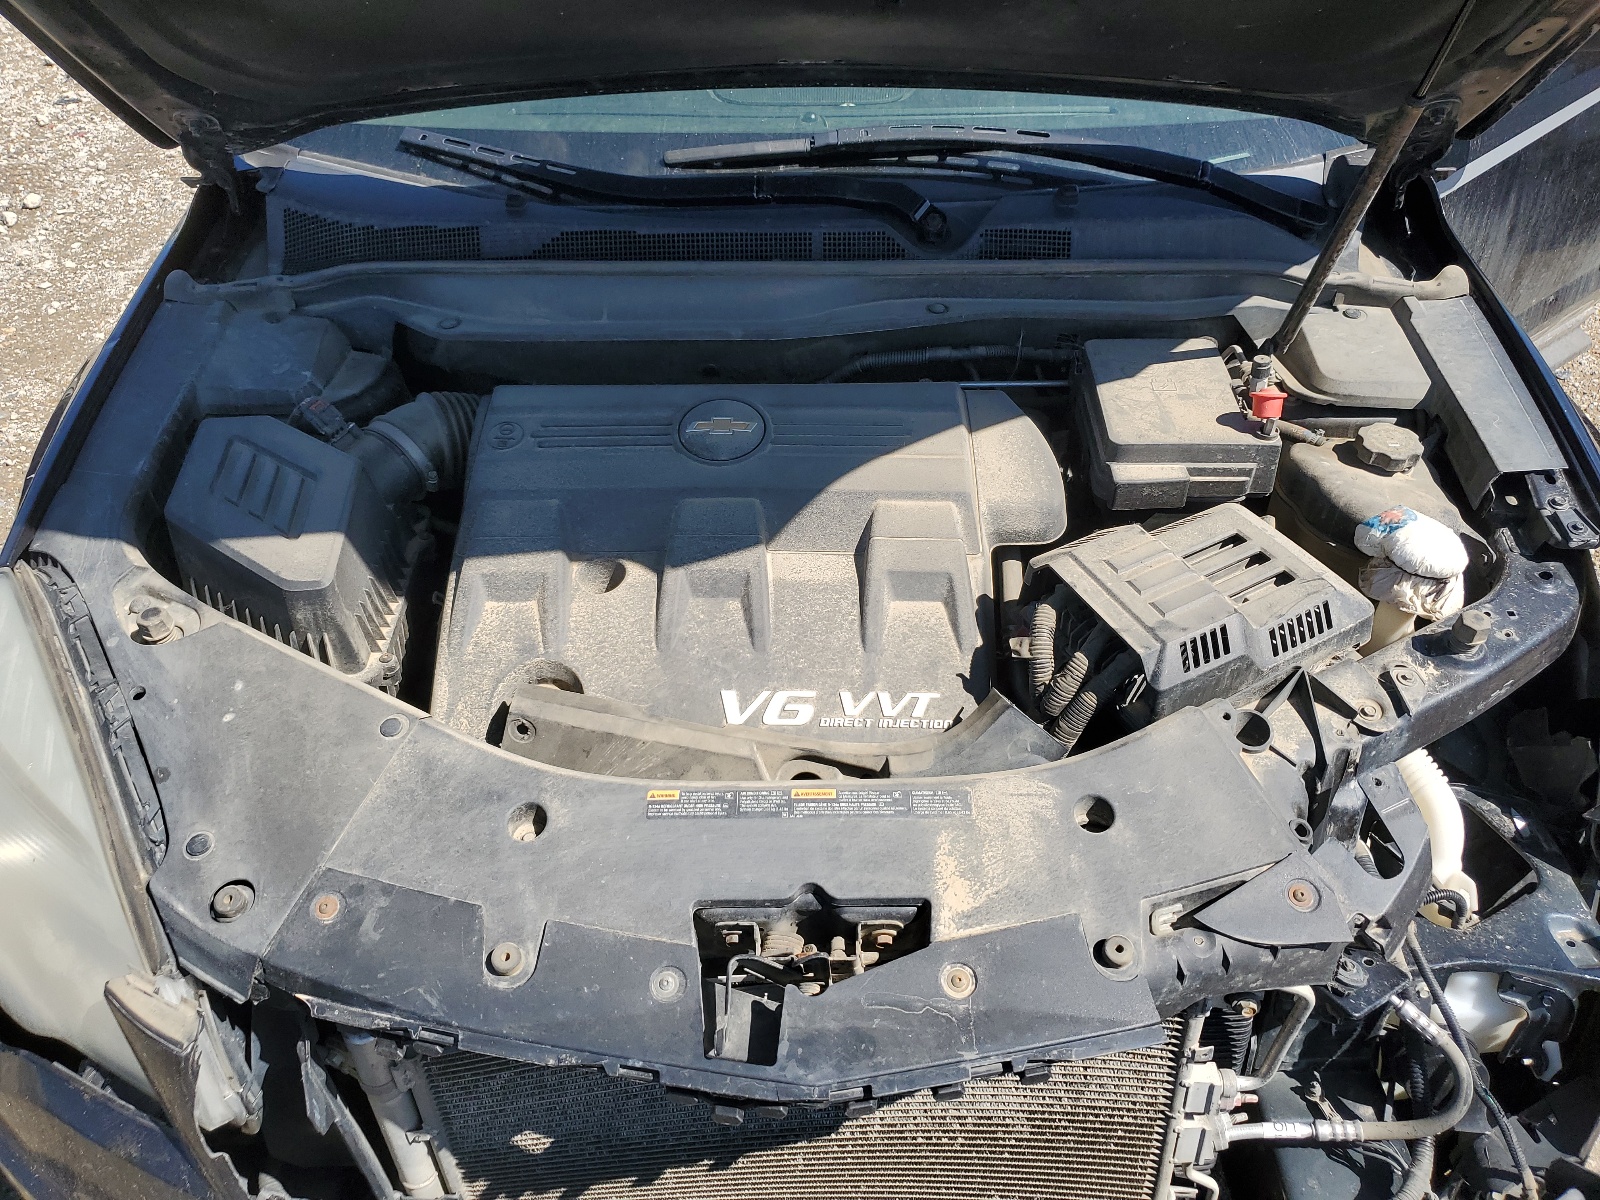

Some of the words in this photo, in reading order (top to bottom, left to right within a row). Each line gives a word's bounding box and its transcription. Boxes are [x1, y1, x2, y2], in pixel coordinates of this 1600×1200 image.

[720, 689, 817, 726] V6
[839, 690, 941, 718] VVT
[819, 717, 874, 728] DIRECT
[878, 718, 953, 730] INJECTION
